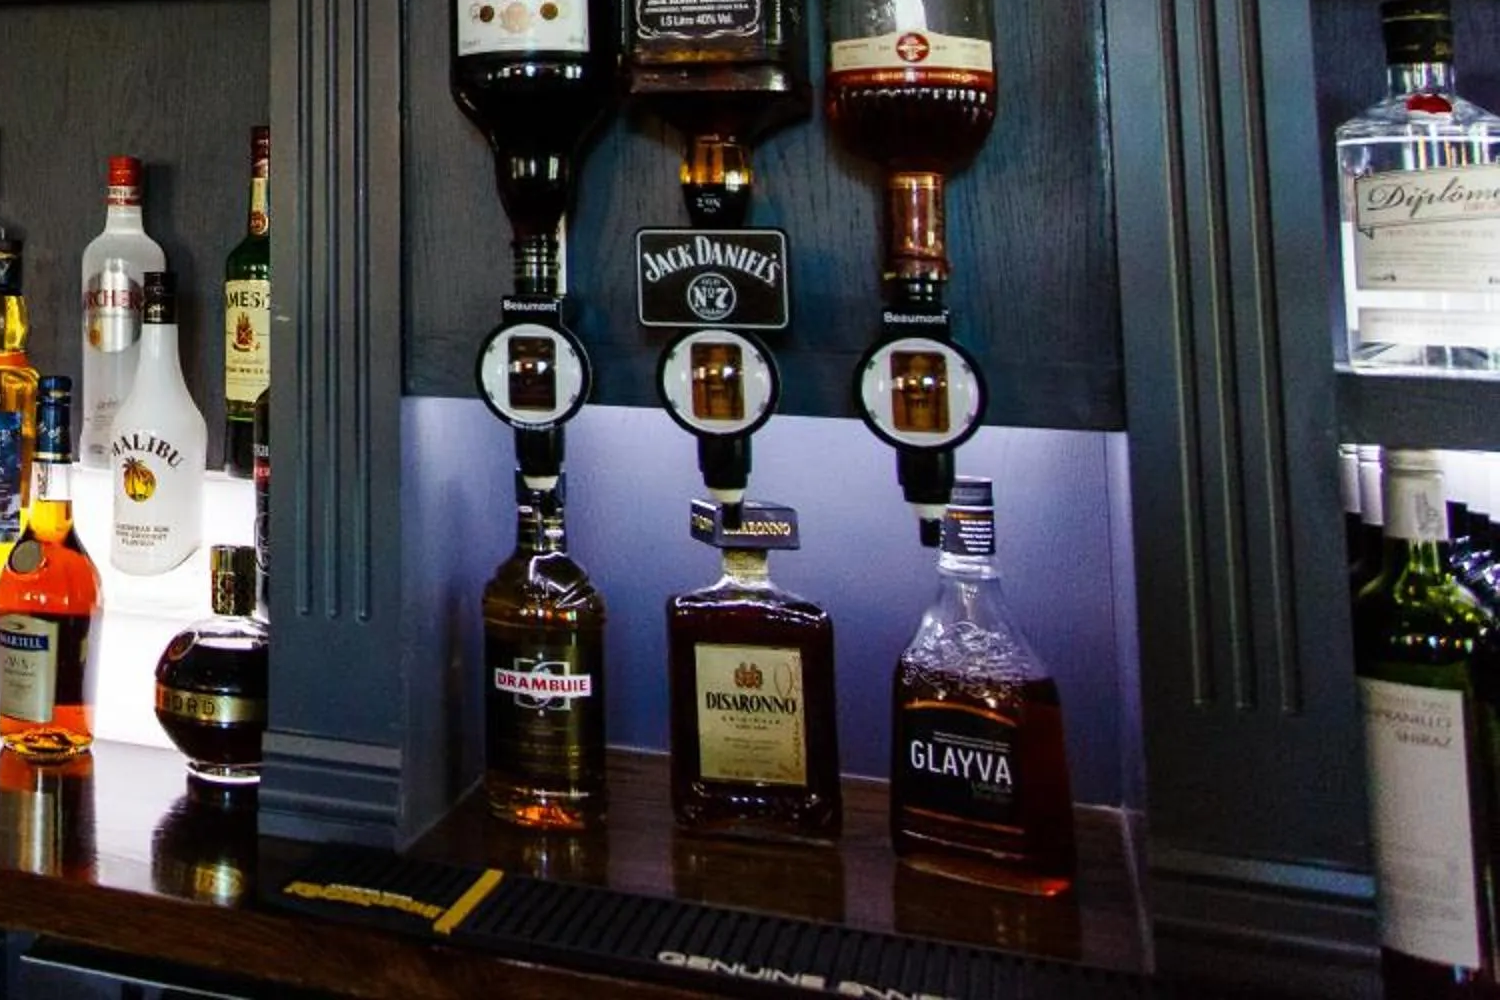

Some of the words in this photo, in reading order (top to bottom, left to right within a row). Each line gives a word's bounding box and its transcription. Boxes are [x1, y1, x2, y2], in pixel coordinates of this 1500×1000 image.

[643, 243, 696, 282] JACK
[695, 235, 781, 287] DANIEL'S
[503, 299, 558, 311] Beaumont
[883, 311, 948, 325] Beaumont
[111, 433, 185, 470] MALIBU
[498, 670, 589, 694] DRAMBUIE
[705, 691, 797, 716] DISARONNO
[910, 739, 1013, 786] GLAYVA
[656, 951, 826, 991] GENUINE
